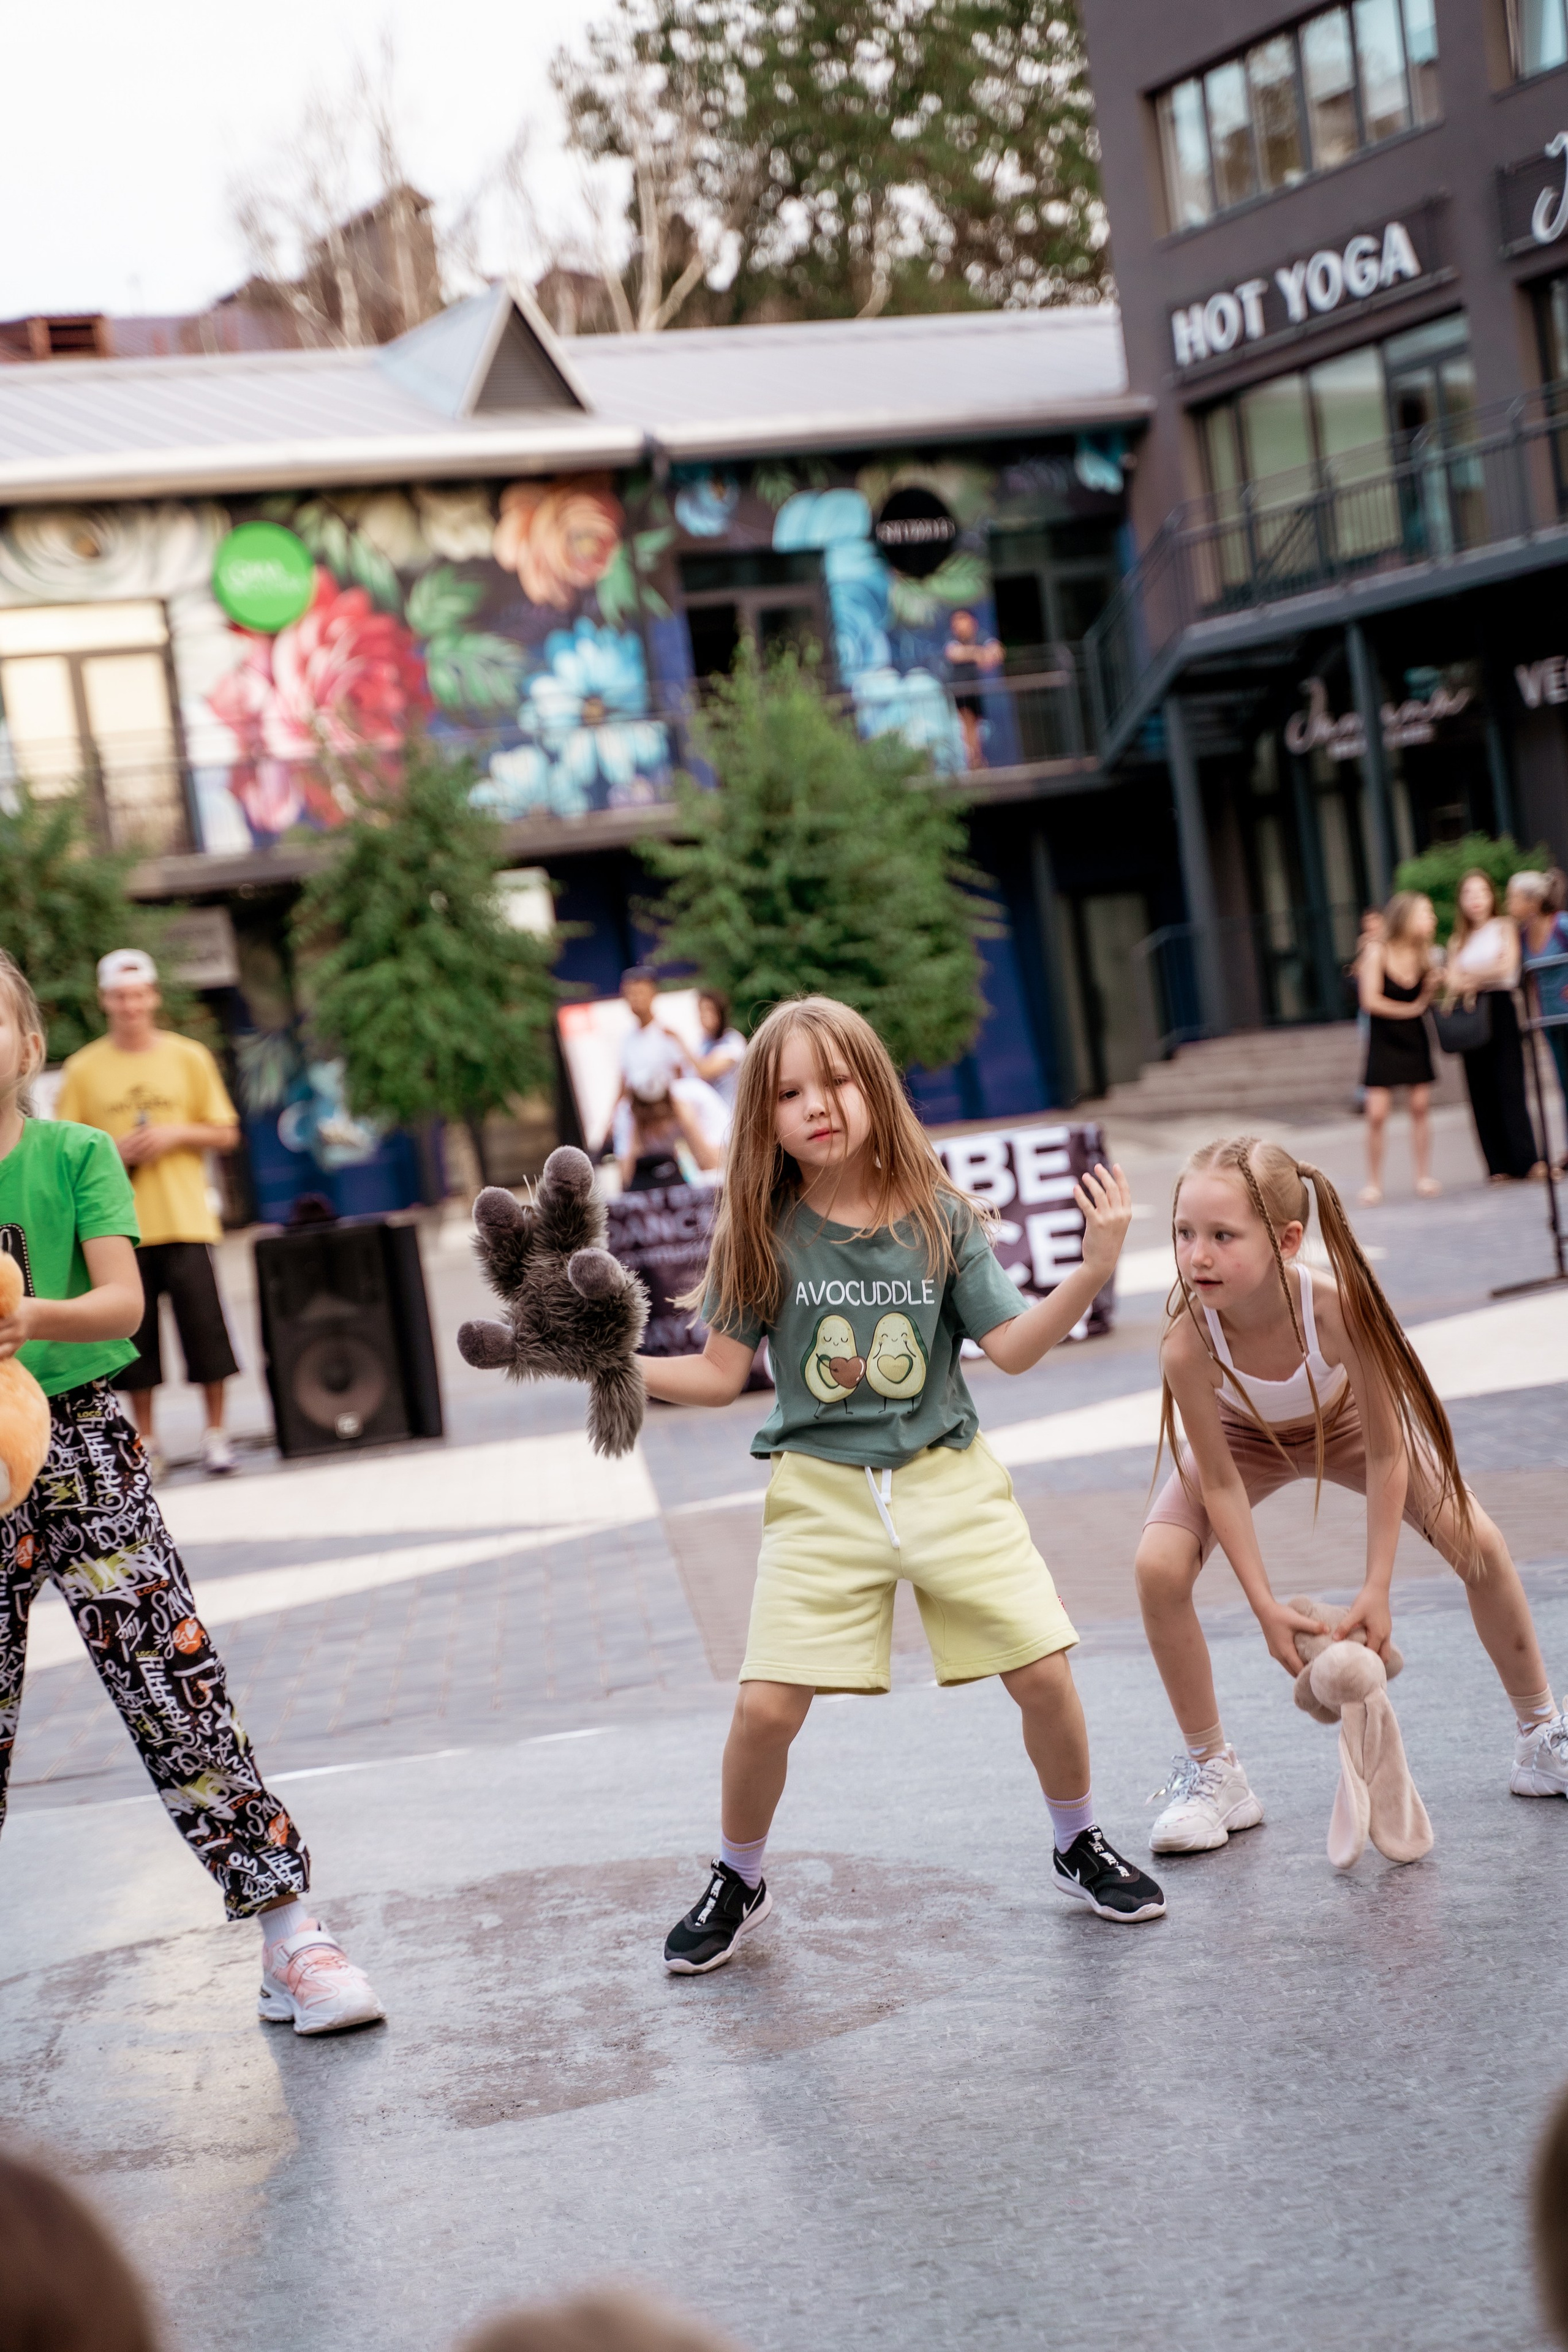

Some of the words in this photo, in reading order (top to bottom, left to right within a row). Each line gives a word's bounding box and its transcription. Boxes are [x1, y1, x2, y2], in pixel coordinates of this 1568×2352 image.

[1171, 278, 1269, 366] HOT
[1274, 221, 1422, 323] YOGA
[934, 1126, 1079, 1212] BE
[796, 1280, 935, 1306] AVOCUDDLE
[77, 1410, 102, 1419] LOCO
[136, 1580, 169, 1597] LOCO
